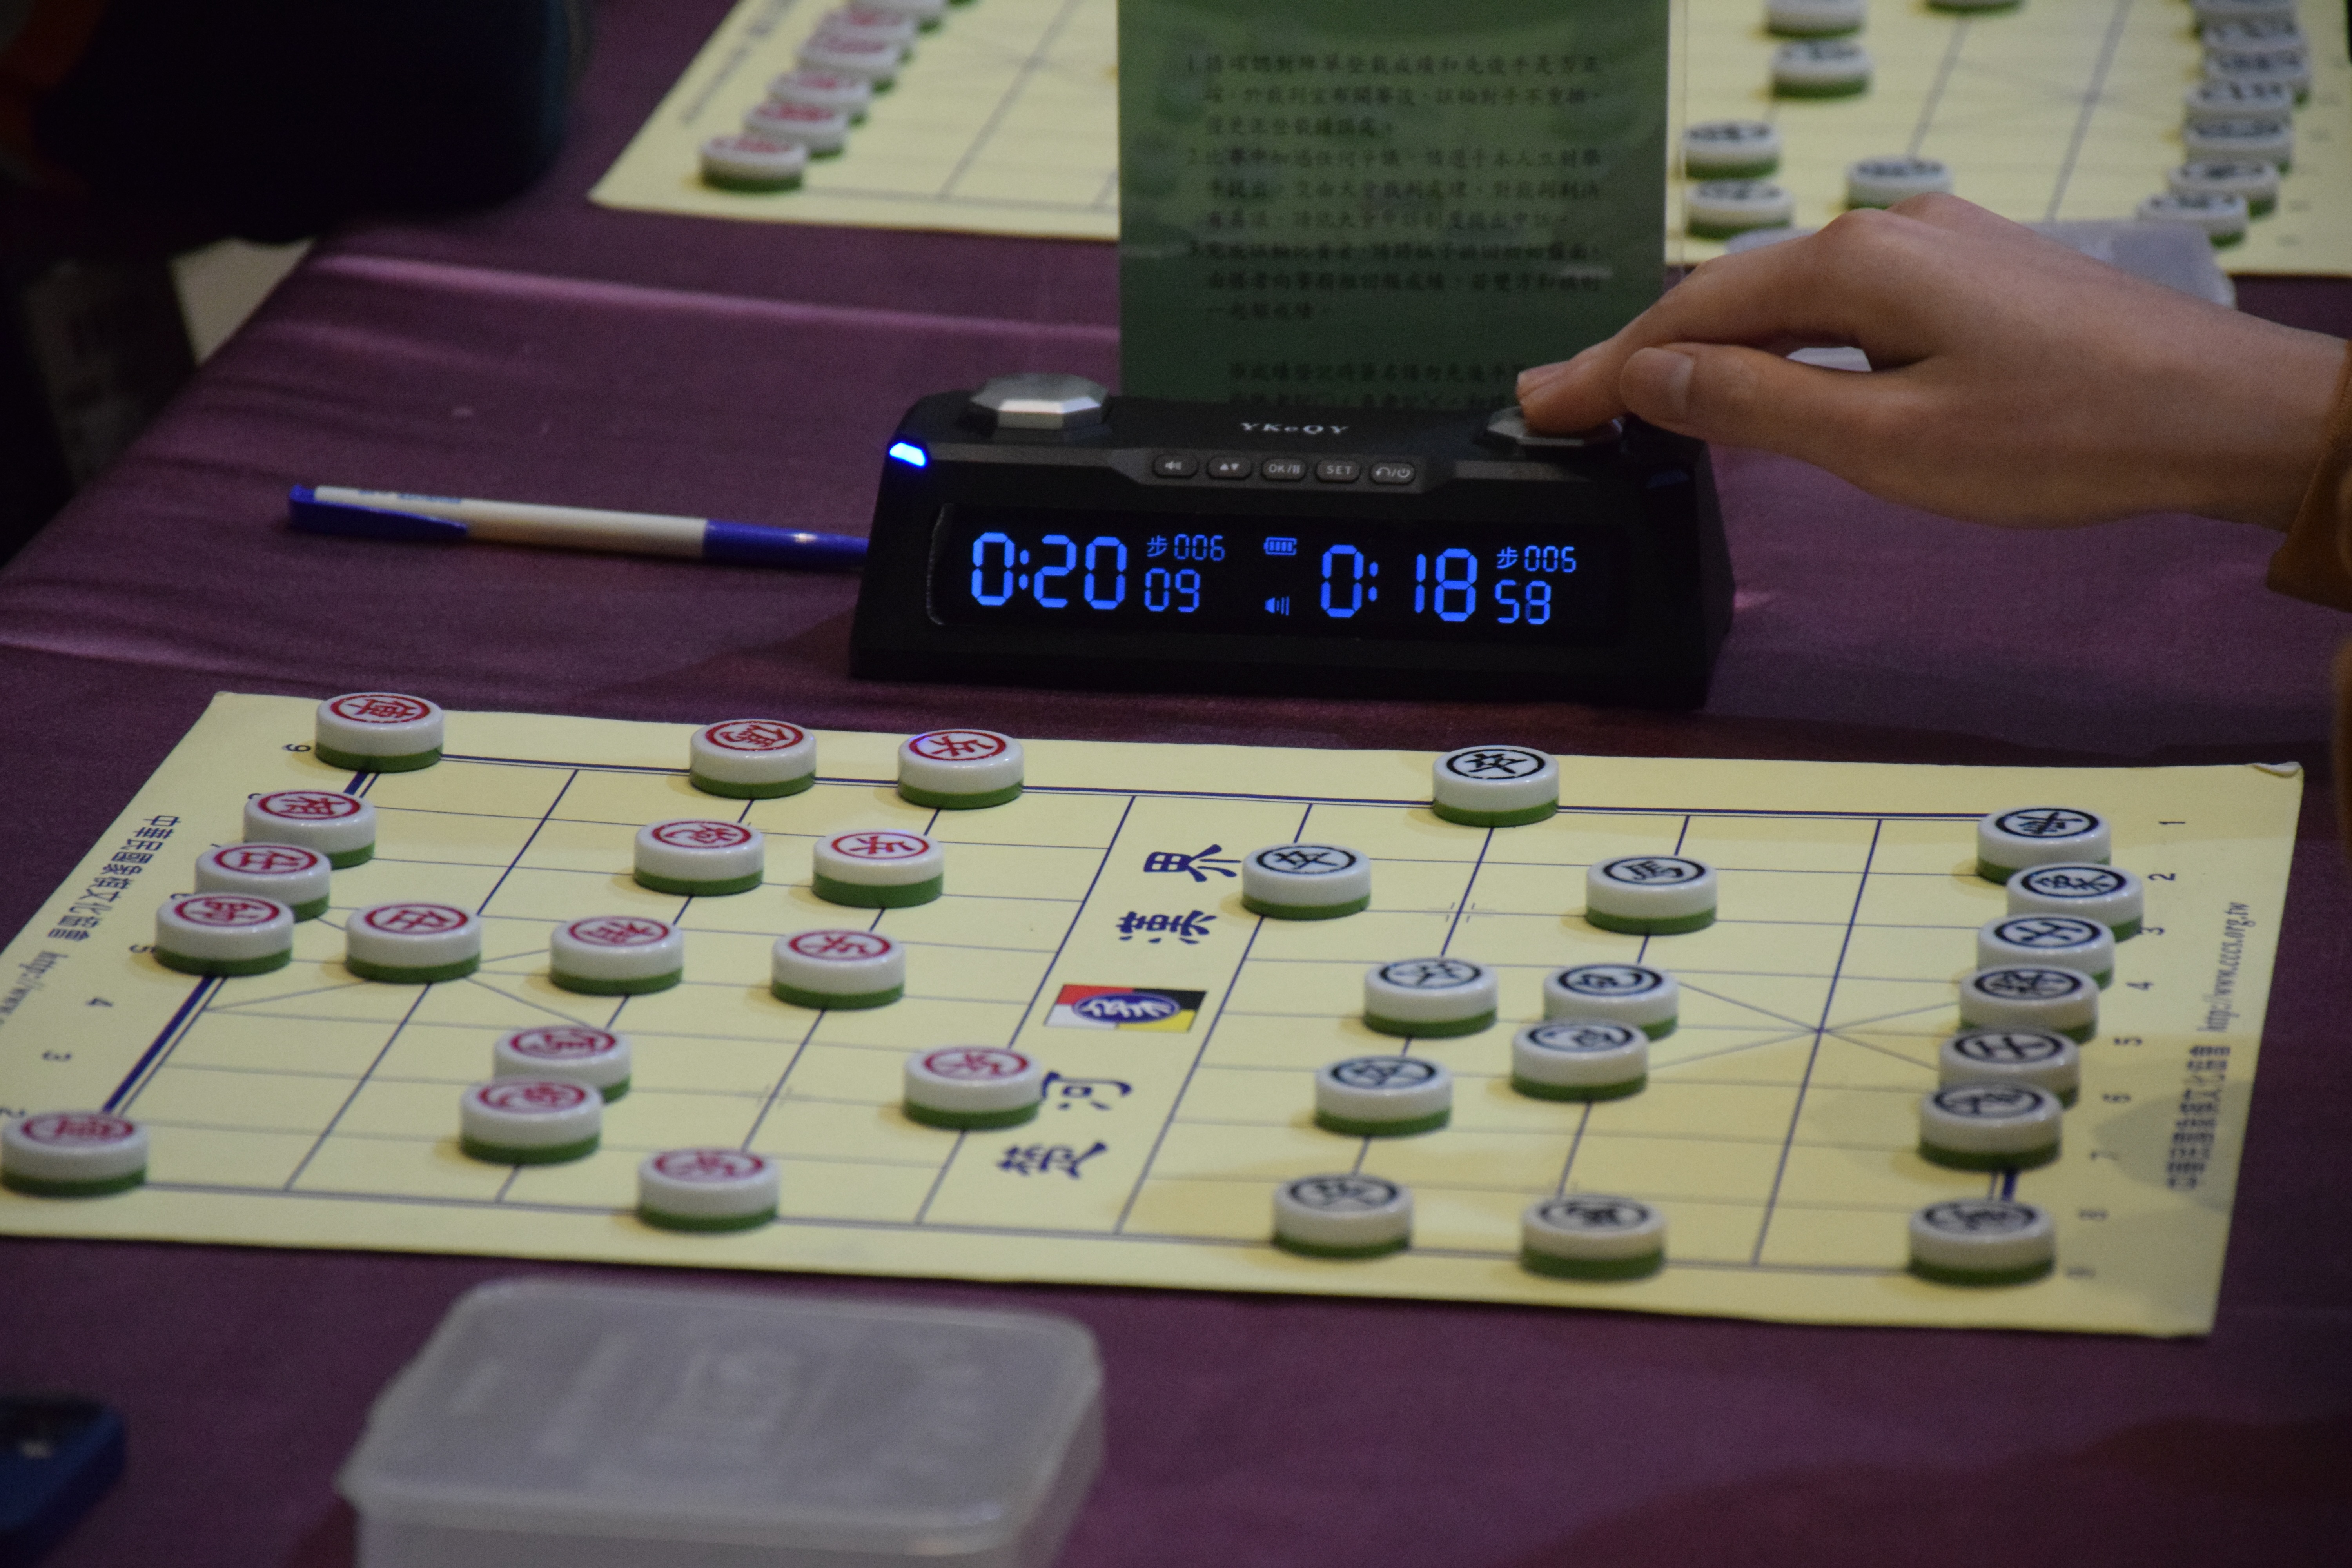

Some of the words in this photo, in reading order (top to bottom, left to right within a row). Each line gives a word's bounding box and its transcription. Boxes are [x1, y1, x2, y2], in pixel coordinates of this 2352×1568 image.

[1326, 465, 1352, 475] SET
[971, 532, 1127, 610] 0:20
[1144, 568, 1201, 613] 09
[1495, 579, 1552, 625] 58
[931, 734, 993, 756] 兵
[279, 797, 345, 815] 相
[850, 835, 915, 855] 兵
[239, 850, 303, 869] 仕
[1625, 860, 1684, 879] 馬
[2149, 873, 2176, 882] 2
[2040, 874, 2108, 891] 象
[2016, 921, 2082, 942] 士
[2126, 982, 2154, 991] 4
[86, 997, 113, 1007] 4
